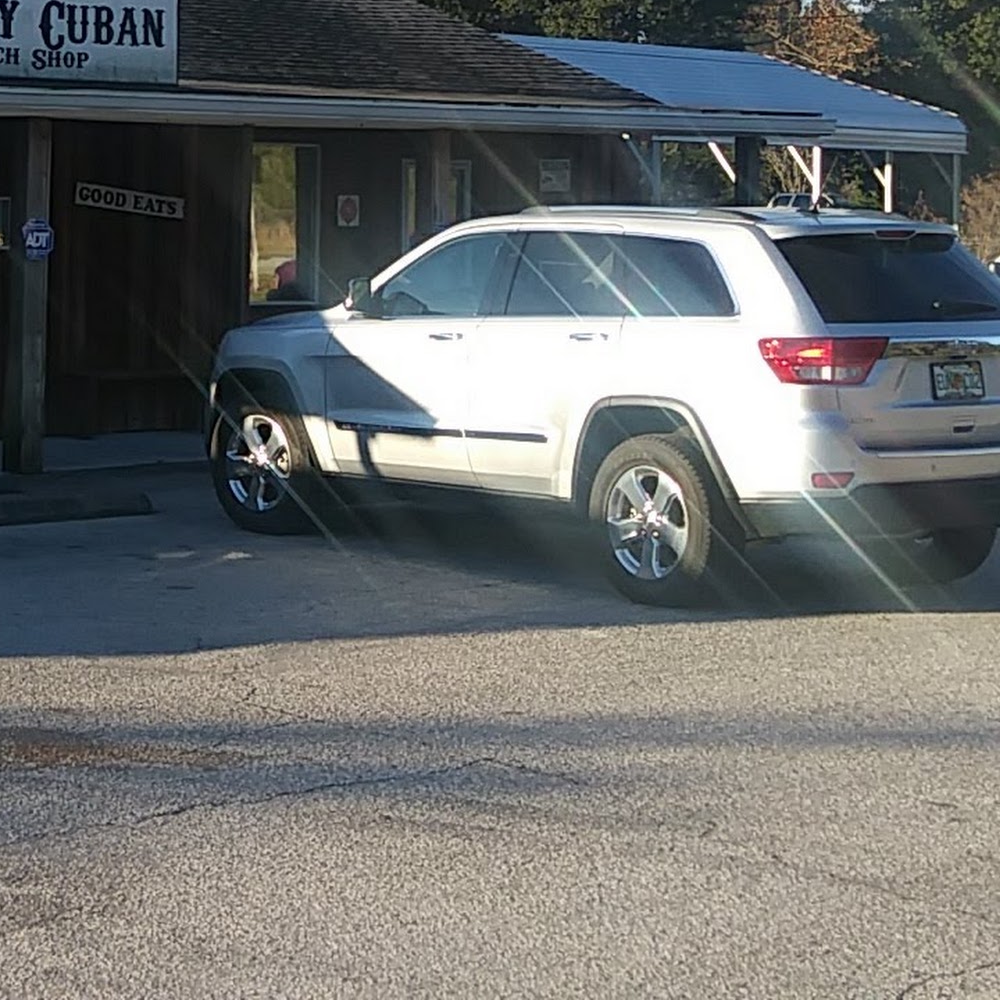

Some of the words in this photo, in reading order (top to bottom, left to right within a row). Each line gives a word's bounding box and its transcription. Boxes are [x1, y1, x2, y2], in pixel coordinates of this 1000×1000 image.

[39, 0, 166, 50] CUBAN
[32, 48, 90, 70] SHOP
[79, 186, 127, 208] GOOD
[133, 194, 177, 215] EATS
[25, 231, 50, 248] ADT
